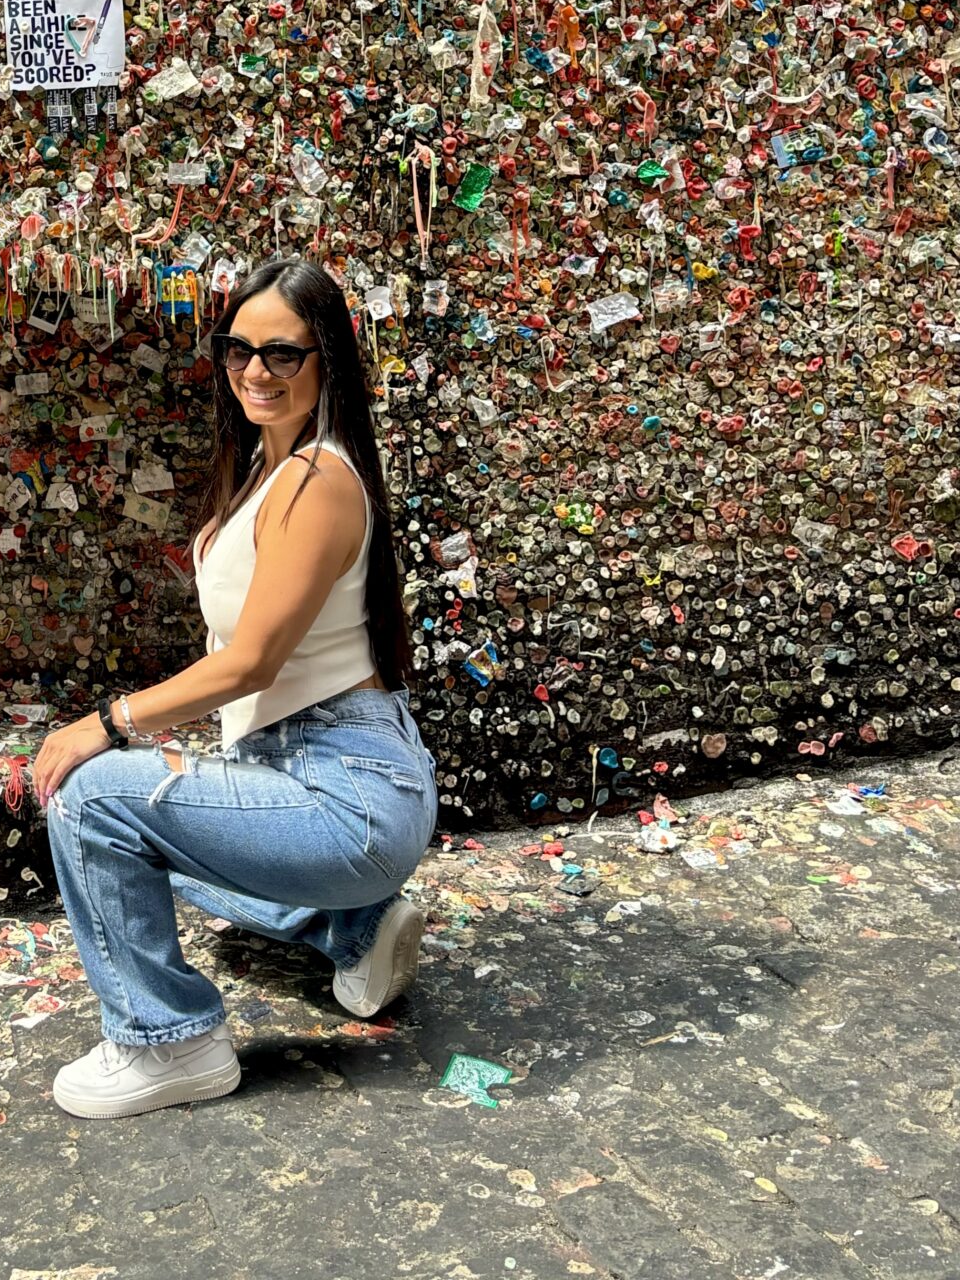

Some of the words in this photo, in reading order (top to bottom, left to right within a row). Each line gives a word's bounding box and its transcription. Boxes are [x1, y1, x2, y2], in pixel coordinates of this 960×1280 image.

[7, 0, 57, 18] BEEN
[9, 18, 21, 35] A
[10, 32, 65, 51] SINCE
[10, 48, 76, 68] YOU'VE
[12, 63, 97, 85] SCORED?
